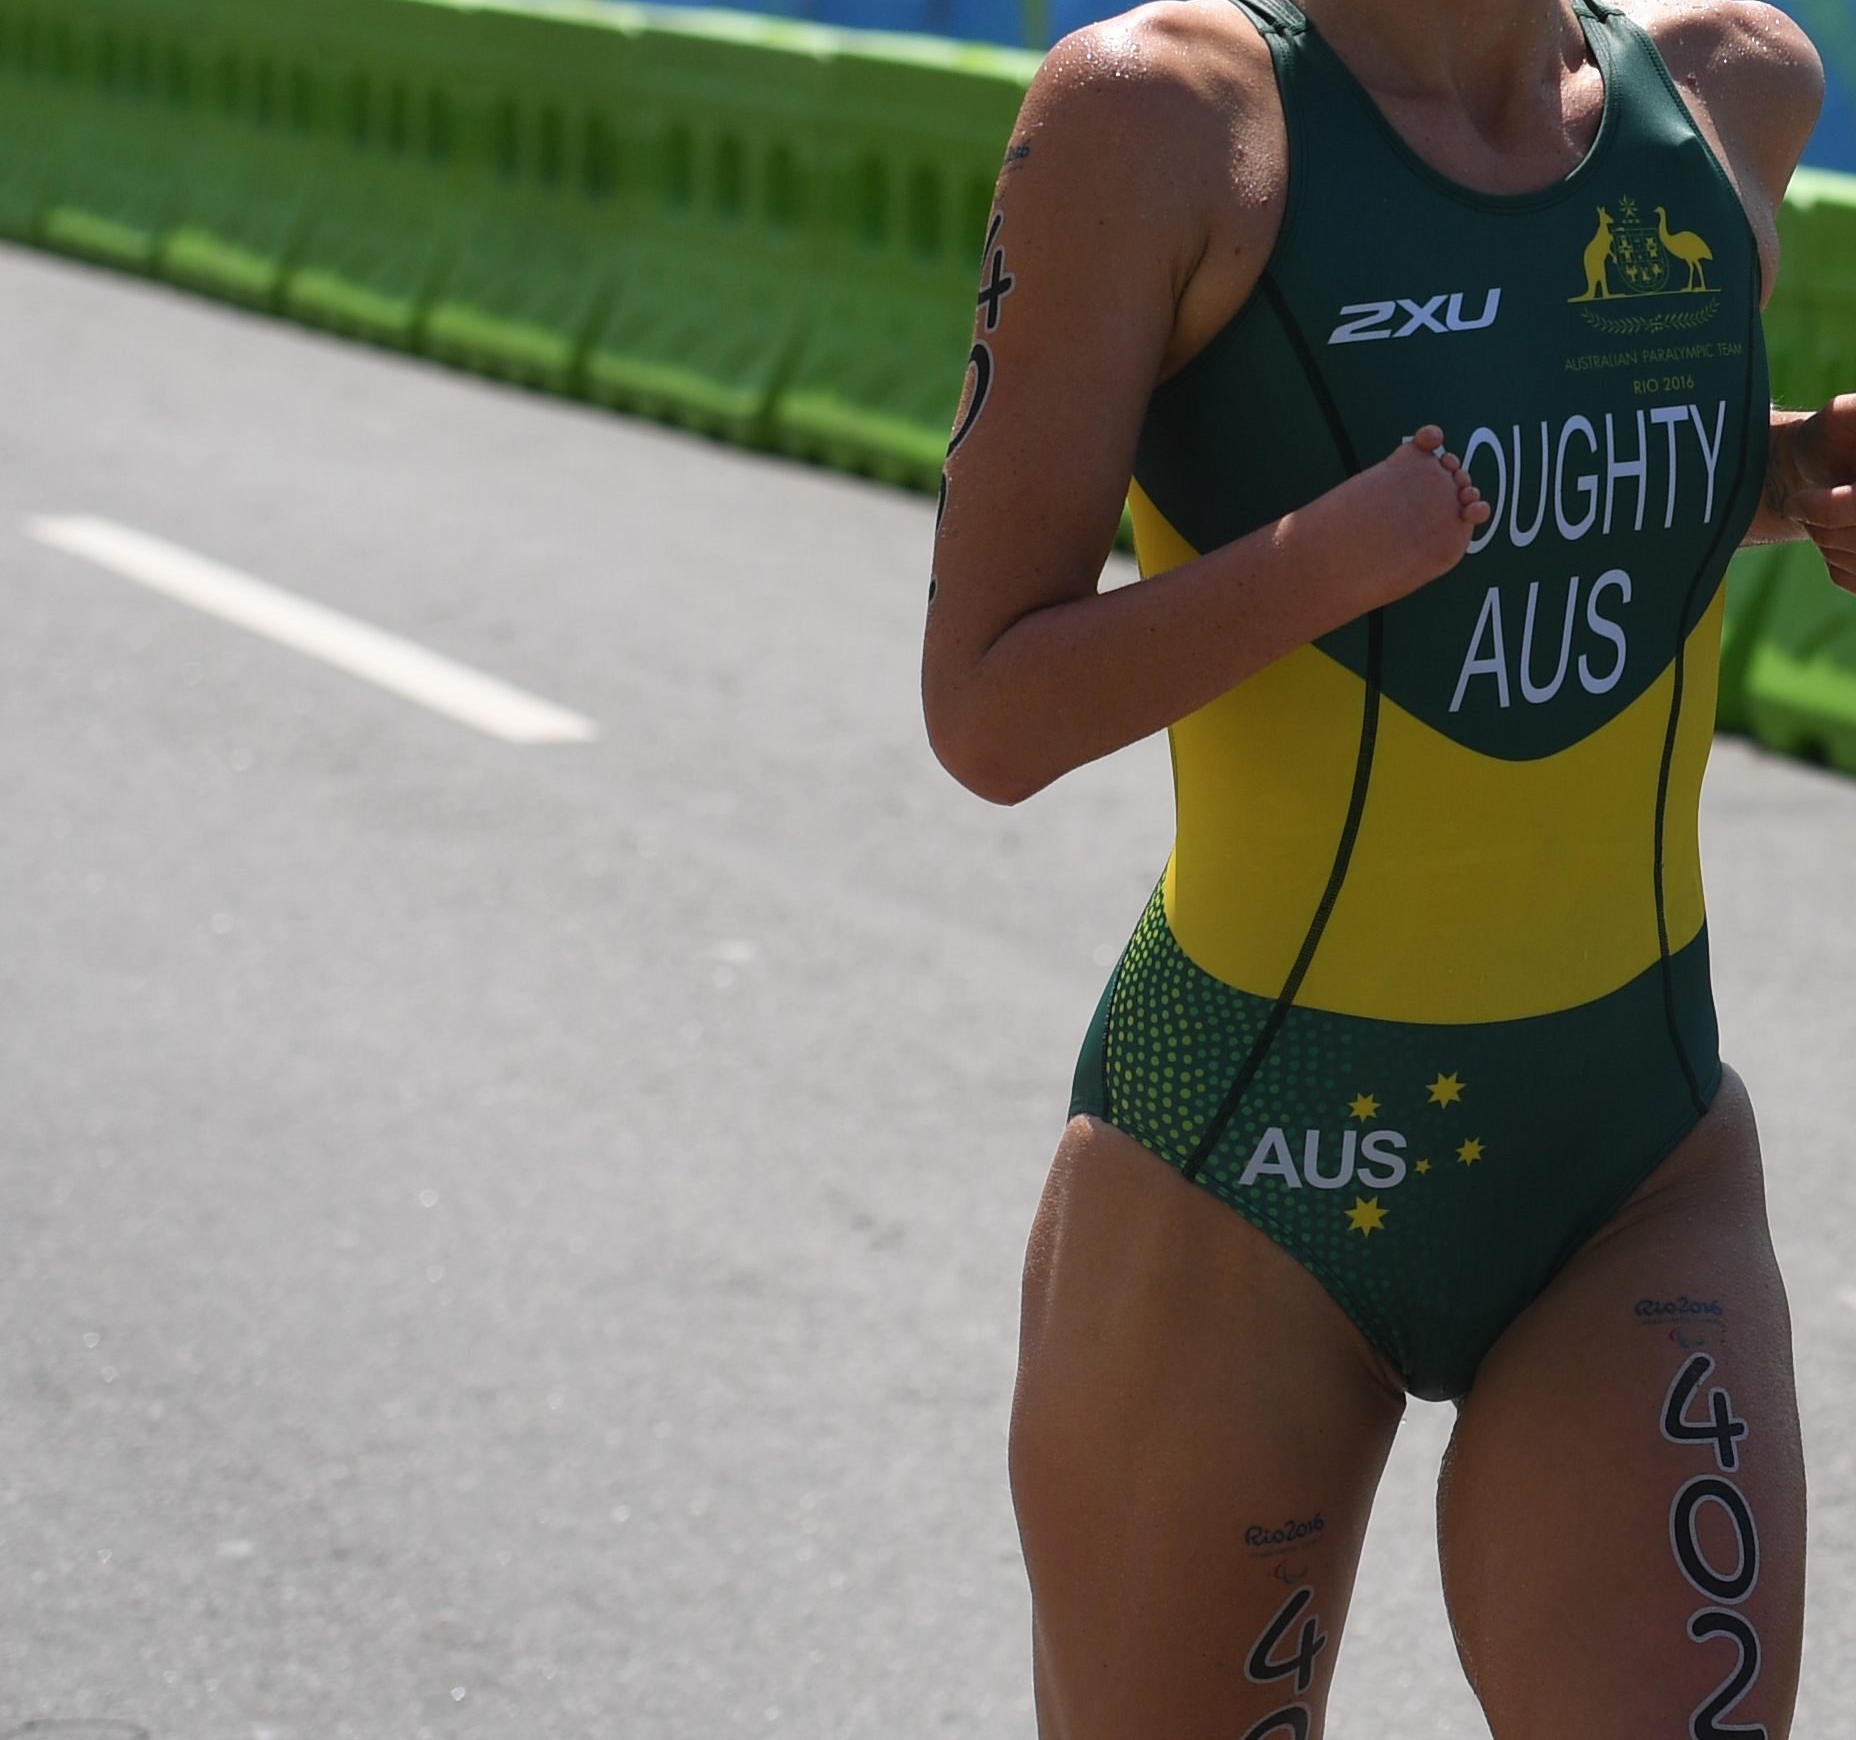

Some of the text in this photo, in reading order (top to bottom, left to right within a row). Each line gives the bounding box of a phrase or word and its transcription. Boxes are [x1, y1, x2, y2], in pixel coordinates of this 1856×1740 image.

[1328, 287, 1502, 345] 2XU
[1564, 342, 1743, 372] AUSTRALIAN PARALYMPIC TEAM
[1633, 375, 1695, 395] RIO 2016
[1402, 400, 1726, 554] OUGHTY
[1448, 568, 1632, 712] AUS
[1238, 1126, 1408, 1189] AUS
[1634, 1296, 1724, 1317] Rio2016
[1244, 1512, 1325, 1547] Rio2016
[1660, 1352, 1768, 1740] 402
